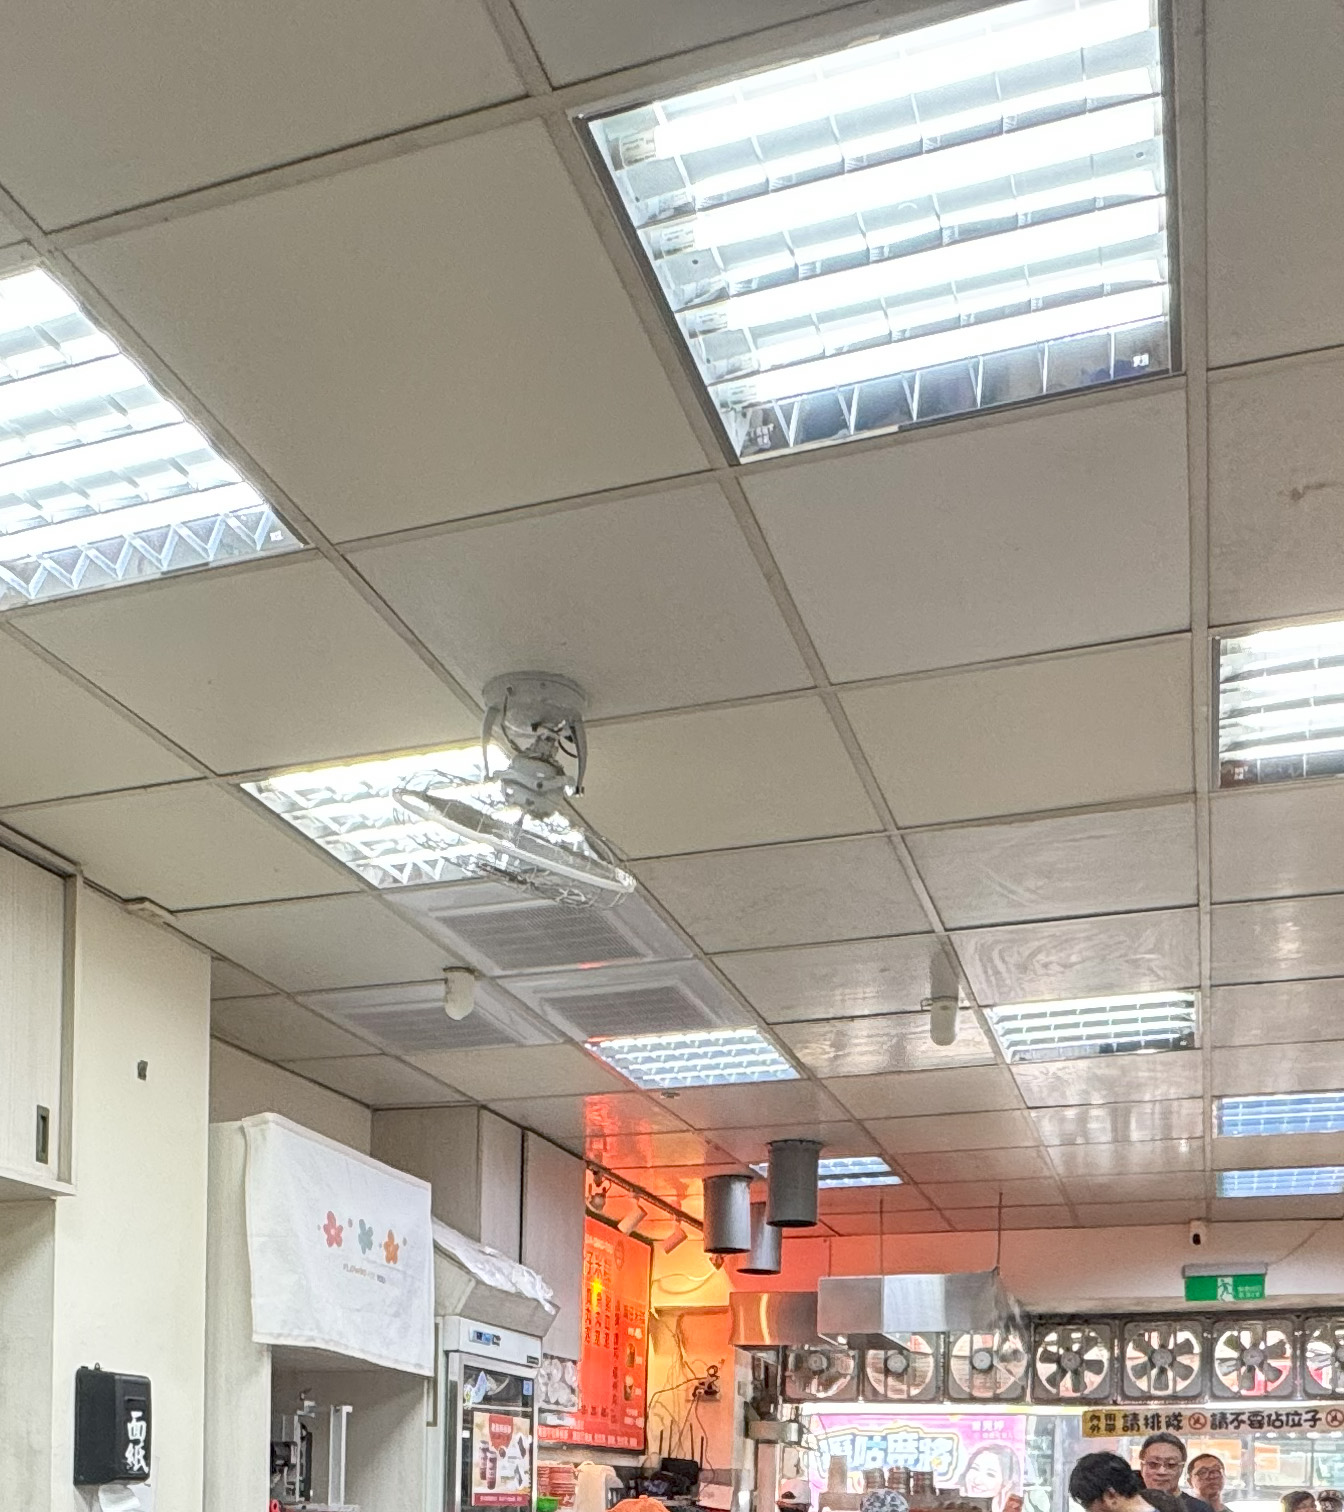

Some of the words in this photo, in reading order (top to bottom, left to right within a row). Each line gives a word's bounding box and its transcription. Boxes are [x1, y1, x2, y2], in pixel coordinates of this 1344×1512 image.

[1210, 1408, 1323, 1430] 請不要佔位子
[124, 1411, 149, 1474] 面紙
